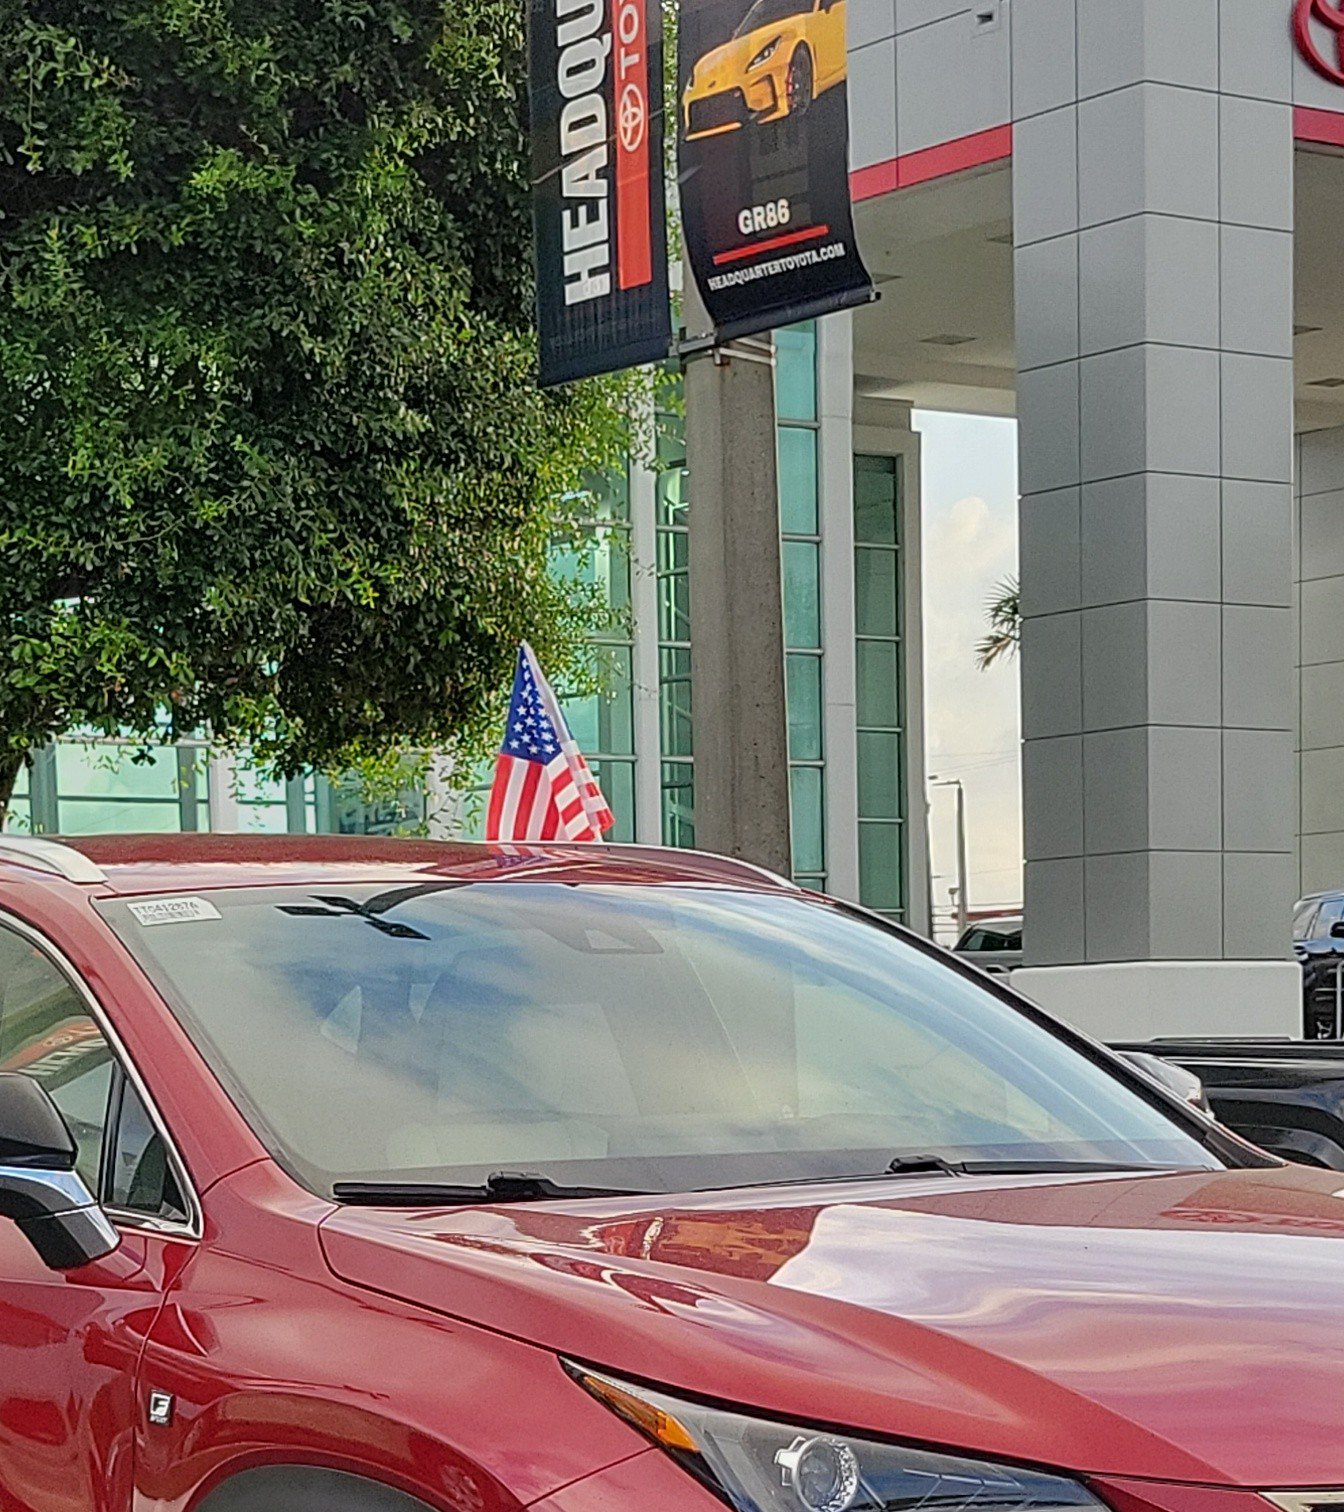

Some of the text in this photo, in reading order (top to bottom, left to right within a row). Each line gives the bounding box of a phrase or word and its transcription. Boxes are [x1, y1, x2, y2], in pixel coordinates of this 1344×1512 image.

[618, 0, 640, 80] TO
[556, 0, 612, 306] HEADQU
[738, 198, 791, 235] GR86
[707, 242, 846, 291] HEADQUARTERTOYOTA.COM
